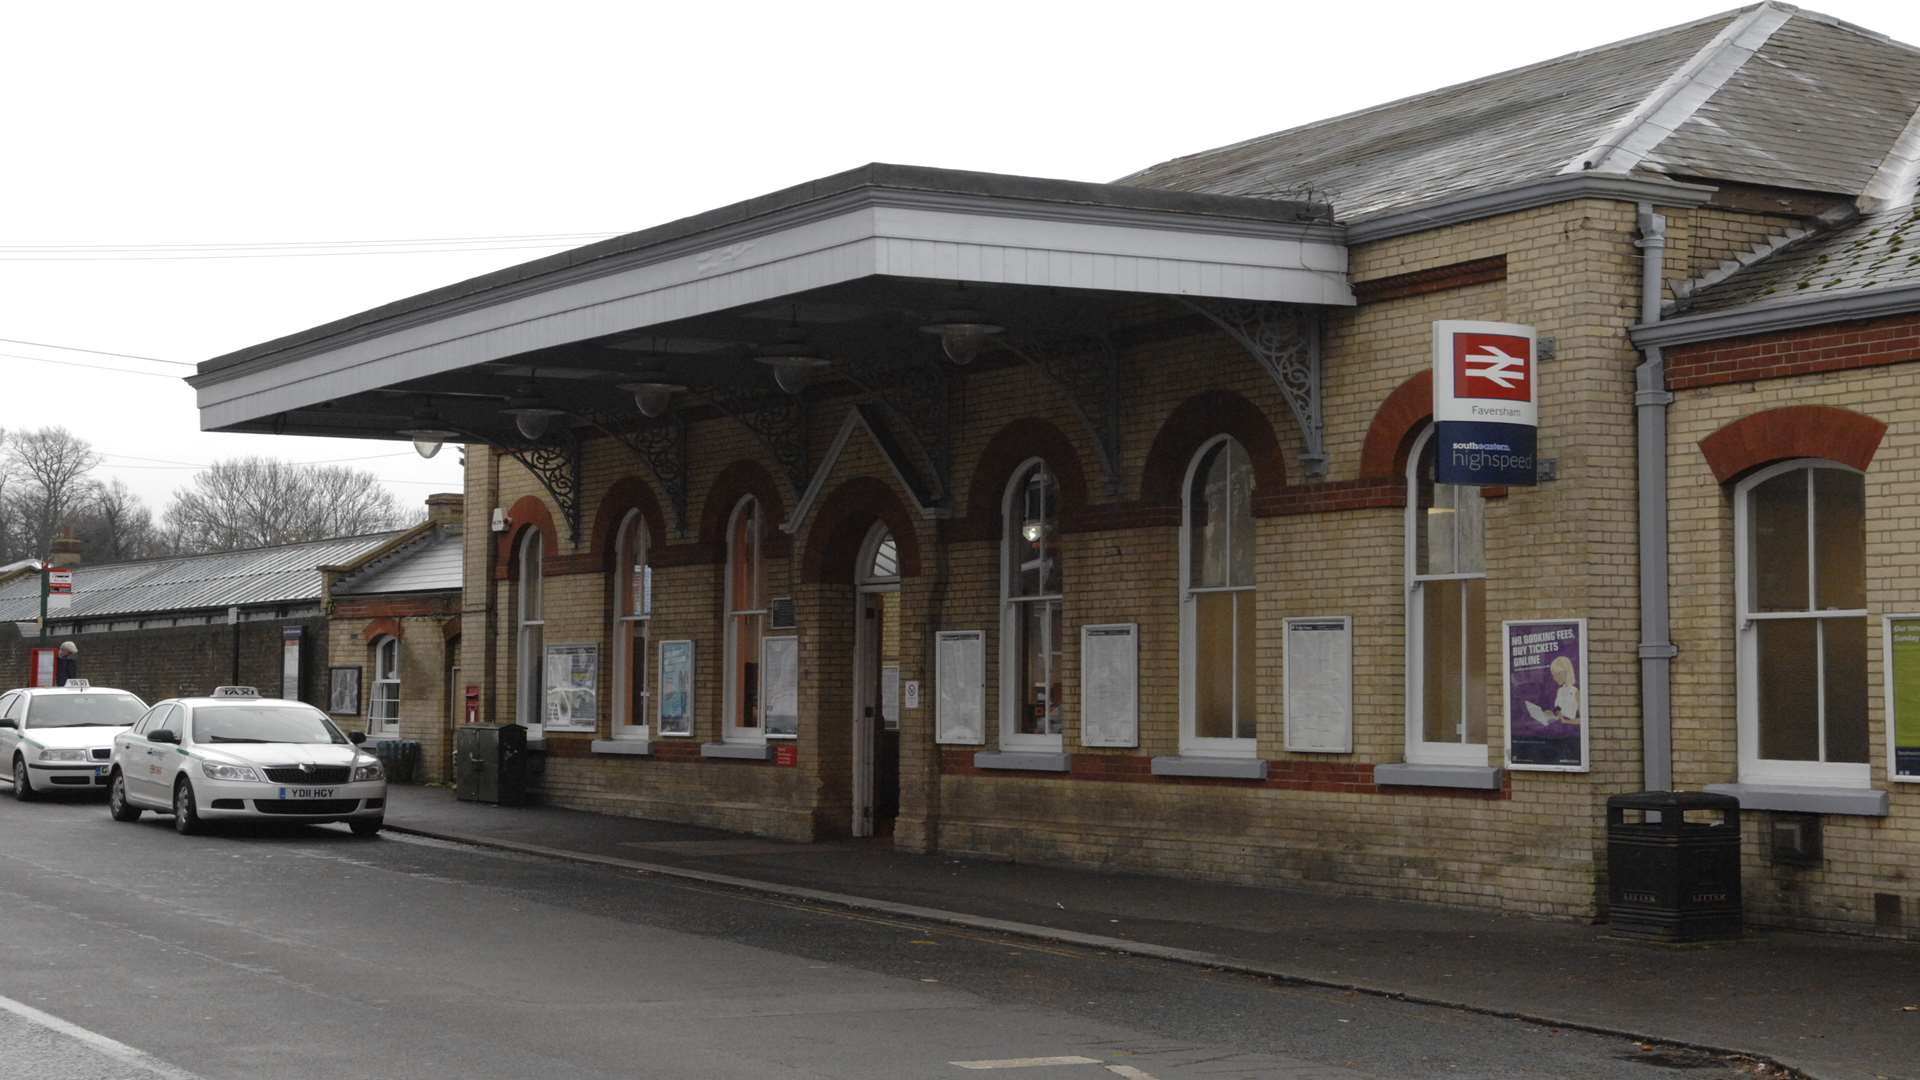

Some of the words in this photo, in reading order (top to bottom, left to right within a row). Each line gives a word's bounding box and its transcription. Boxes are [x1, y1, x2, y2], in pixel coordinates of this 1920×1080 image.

[1472, 405, 1520, 416] Faversham
[1452, 441, 1511, 451] southeastern
[1453, 451, 1532, 470] highspeed
[1523, 632, 1556, 644] BOOKING
[1512, 646, 1528, 657] BUY
[1529, 642, 1559, 655] TICKETS
[1513, 655, 1540, 666] ONLINE
[223, 687, 255, 696] TAXI
[314, 788, 335, 798] HGY
